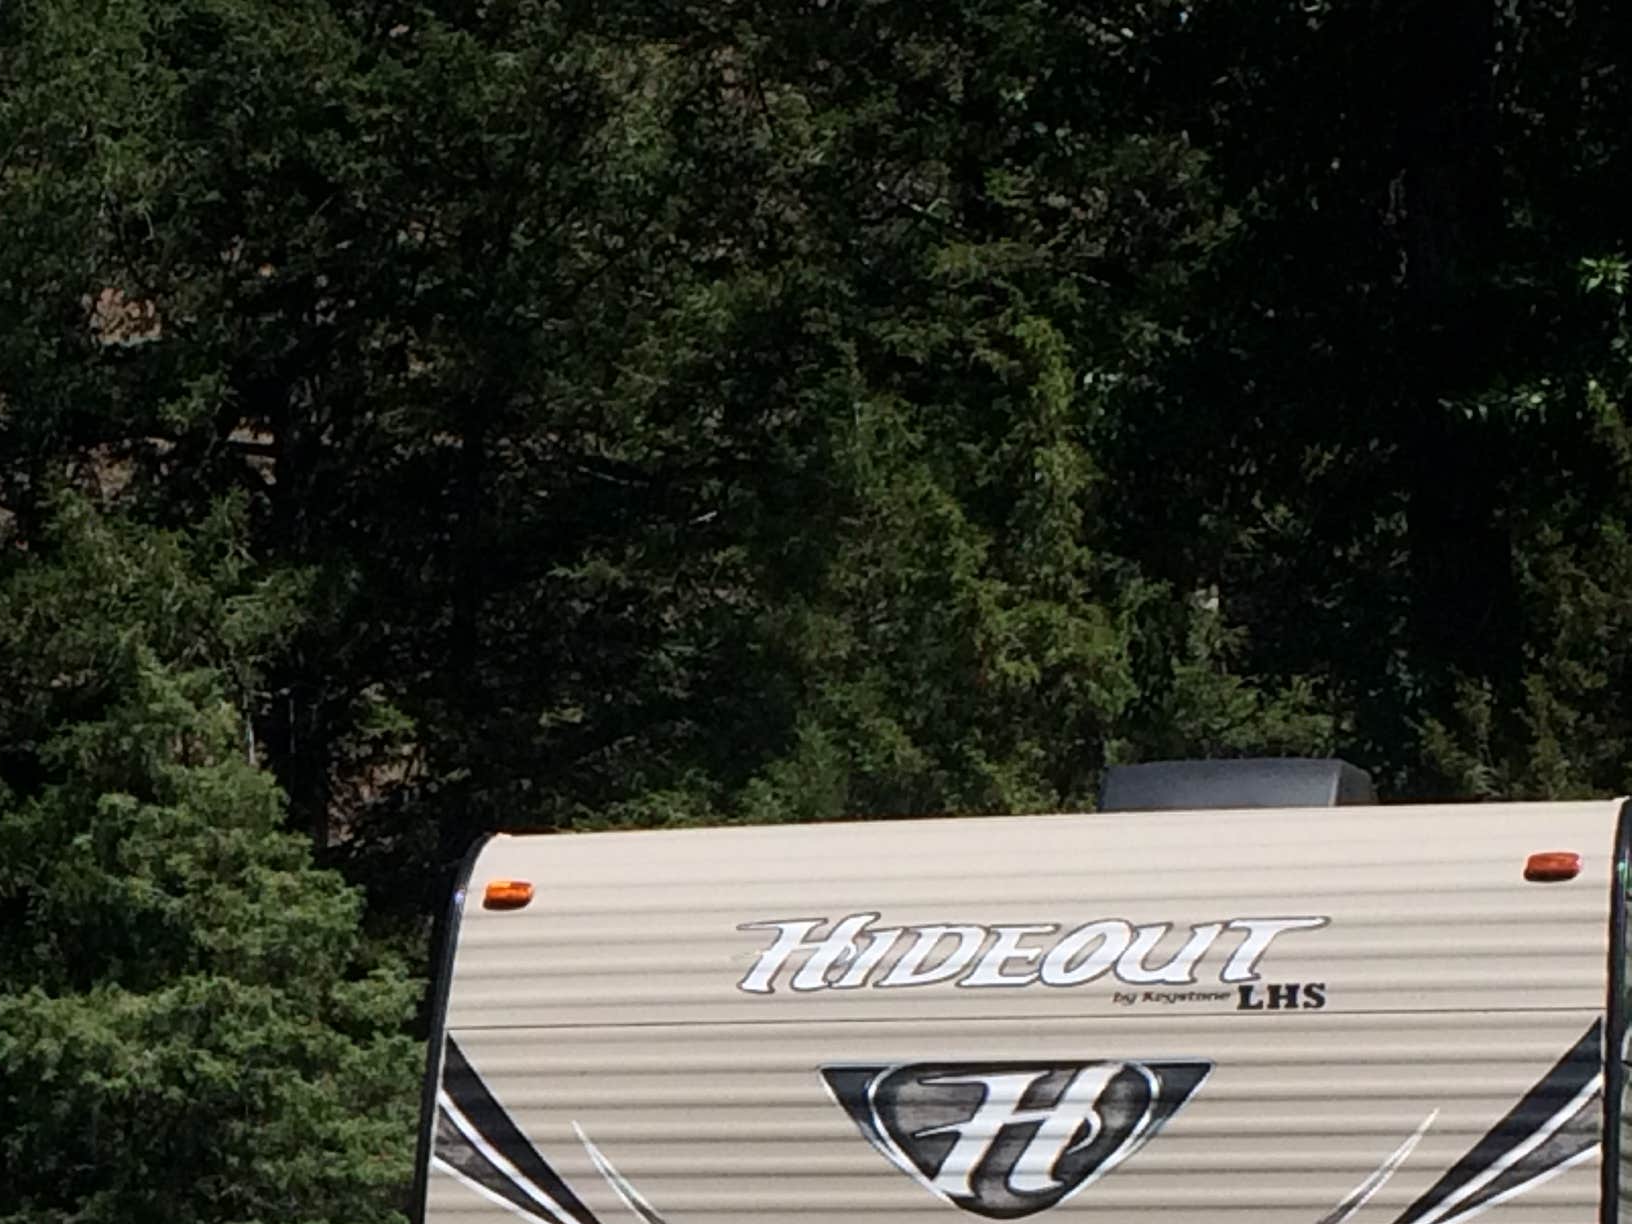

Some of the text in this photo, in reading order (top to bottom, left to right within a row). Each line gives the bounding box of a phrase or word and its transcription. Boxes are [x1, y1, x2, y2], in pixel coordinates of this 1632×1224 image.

[737, 912, 1332, 993] HIDEOUT
[1112, 983, 1326, 1010] by Keystone LHS
[914, 1061, 1126, 1200] H
